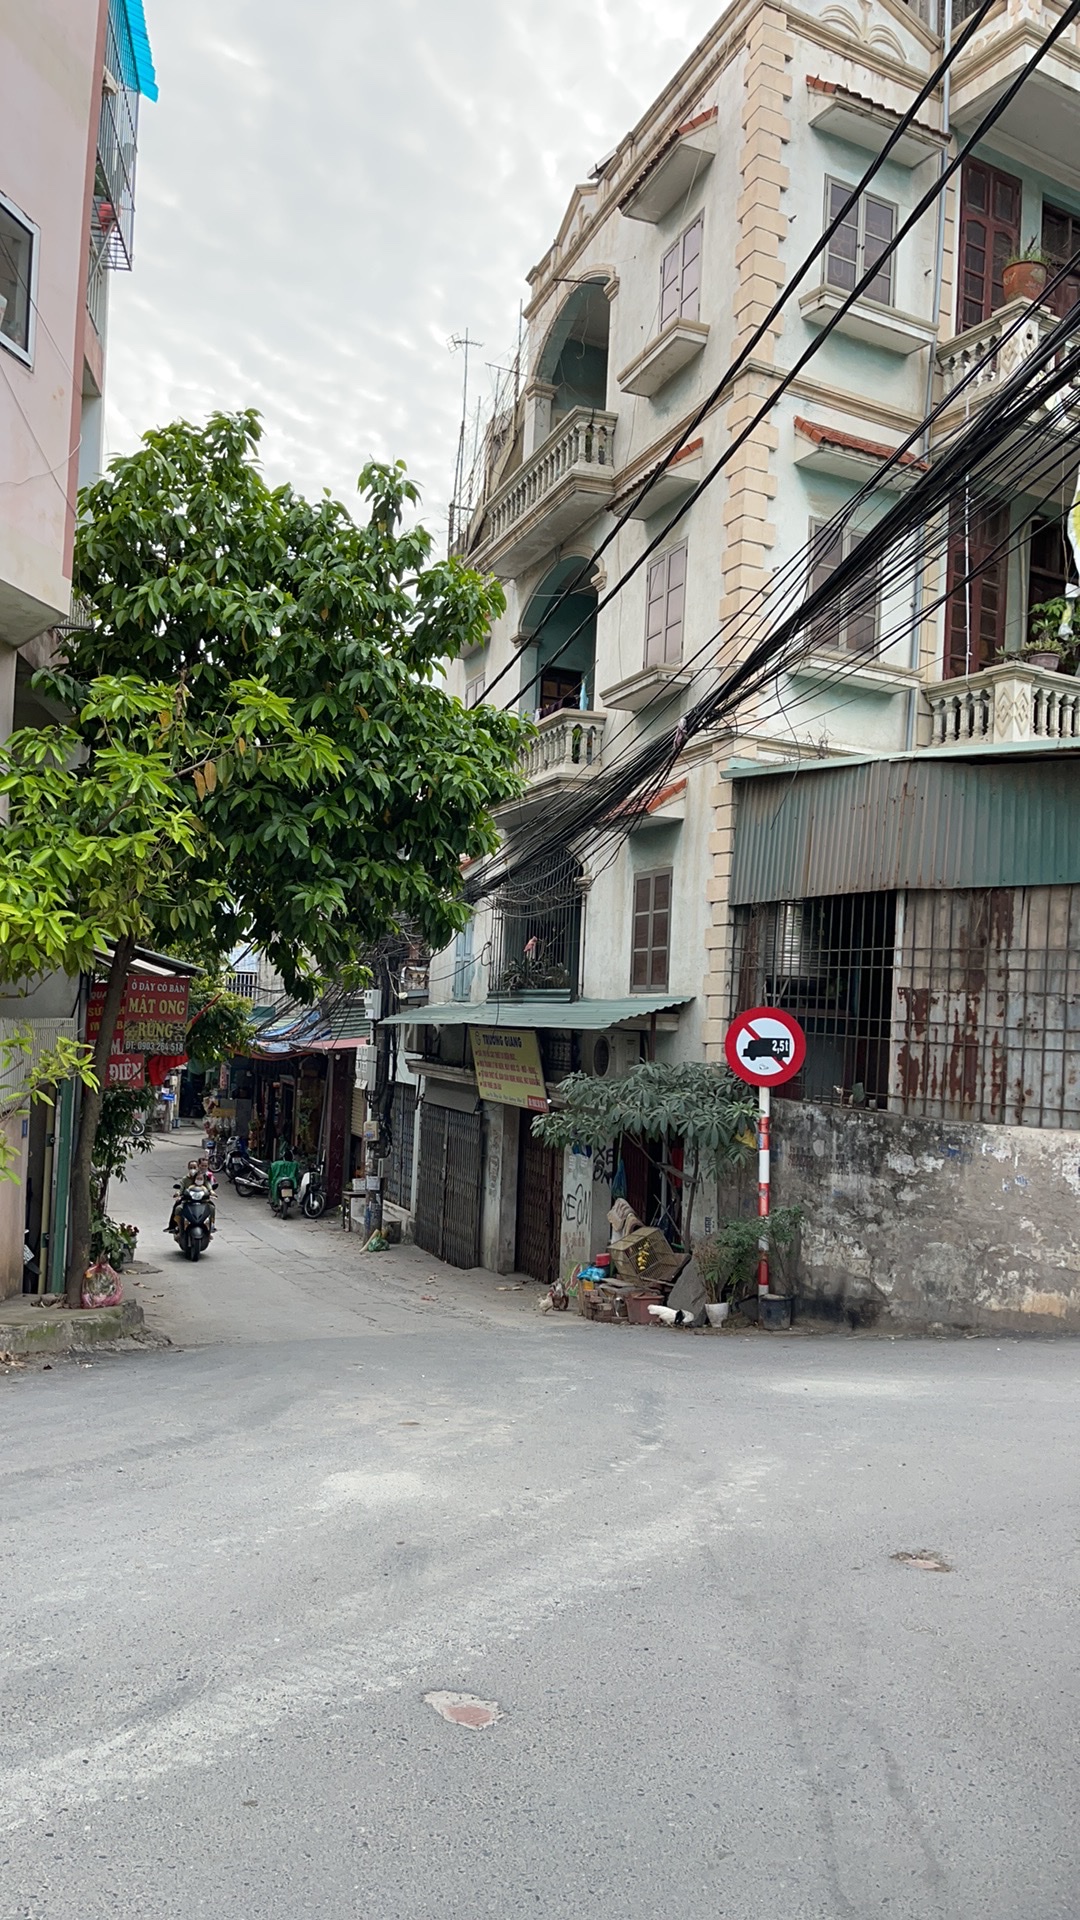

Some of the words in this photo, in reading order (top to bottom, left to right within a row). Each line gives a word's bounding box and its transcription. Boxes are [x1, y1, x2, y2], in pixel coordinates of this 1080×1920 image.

[128, 994, 156, 1017] MẬT
[158, 1000, 185, 1016] ONG
[772, 1039, 789, 1054] 2,5t
